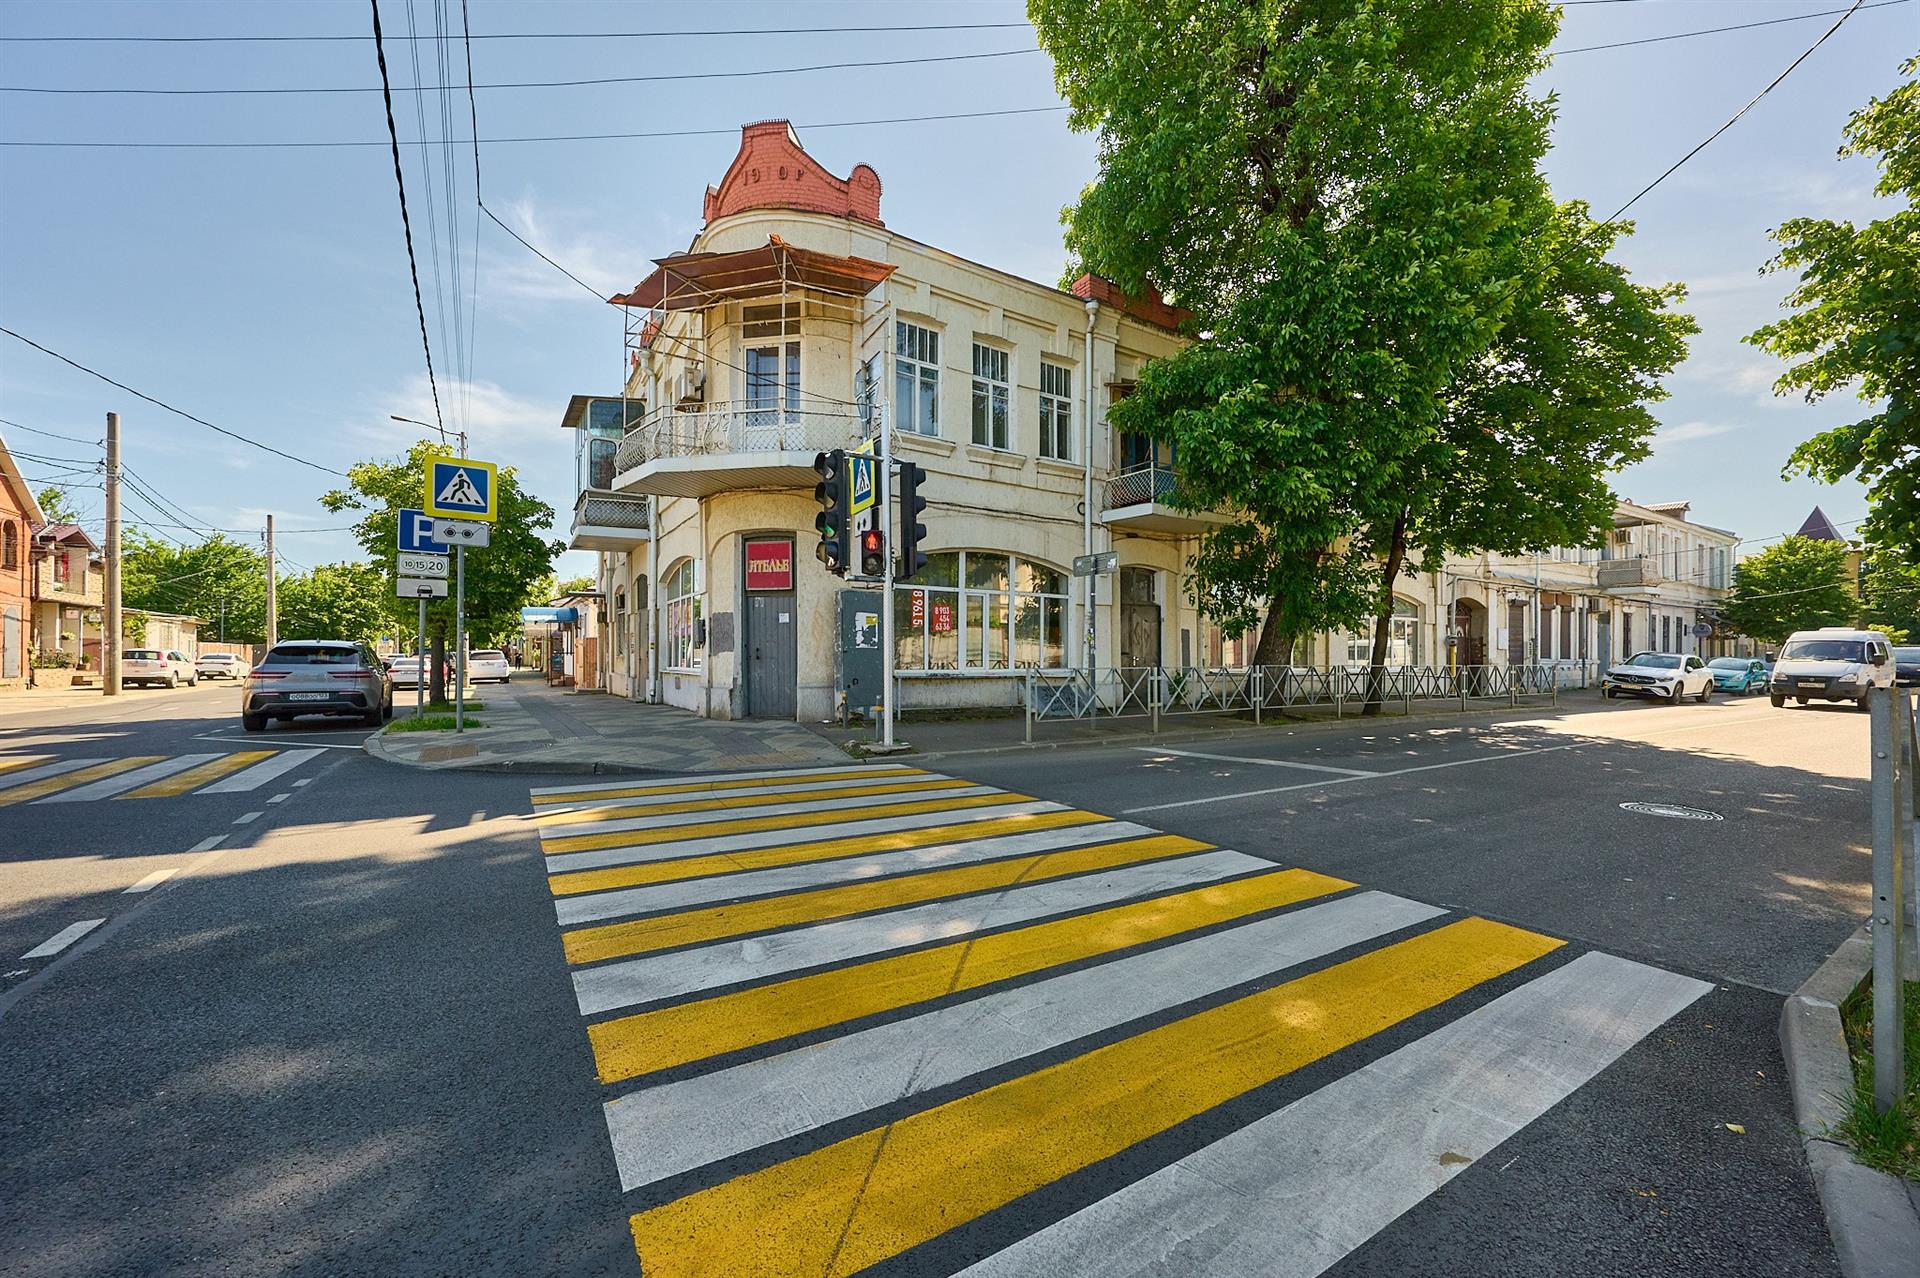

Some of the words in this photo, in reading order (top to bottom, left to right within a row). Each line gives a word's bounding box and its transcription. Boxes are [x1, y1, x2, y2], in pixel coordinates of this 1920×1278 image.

[413, 514, 434, 547] P
[416, 561, 425, 569] 15
[428, 561, 443, 571] 20
[749, 559, 789, 573] АТЕЛЬЕ
[913, 599, 923, 616] 961
[939, 606, 950, 614] 903
